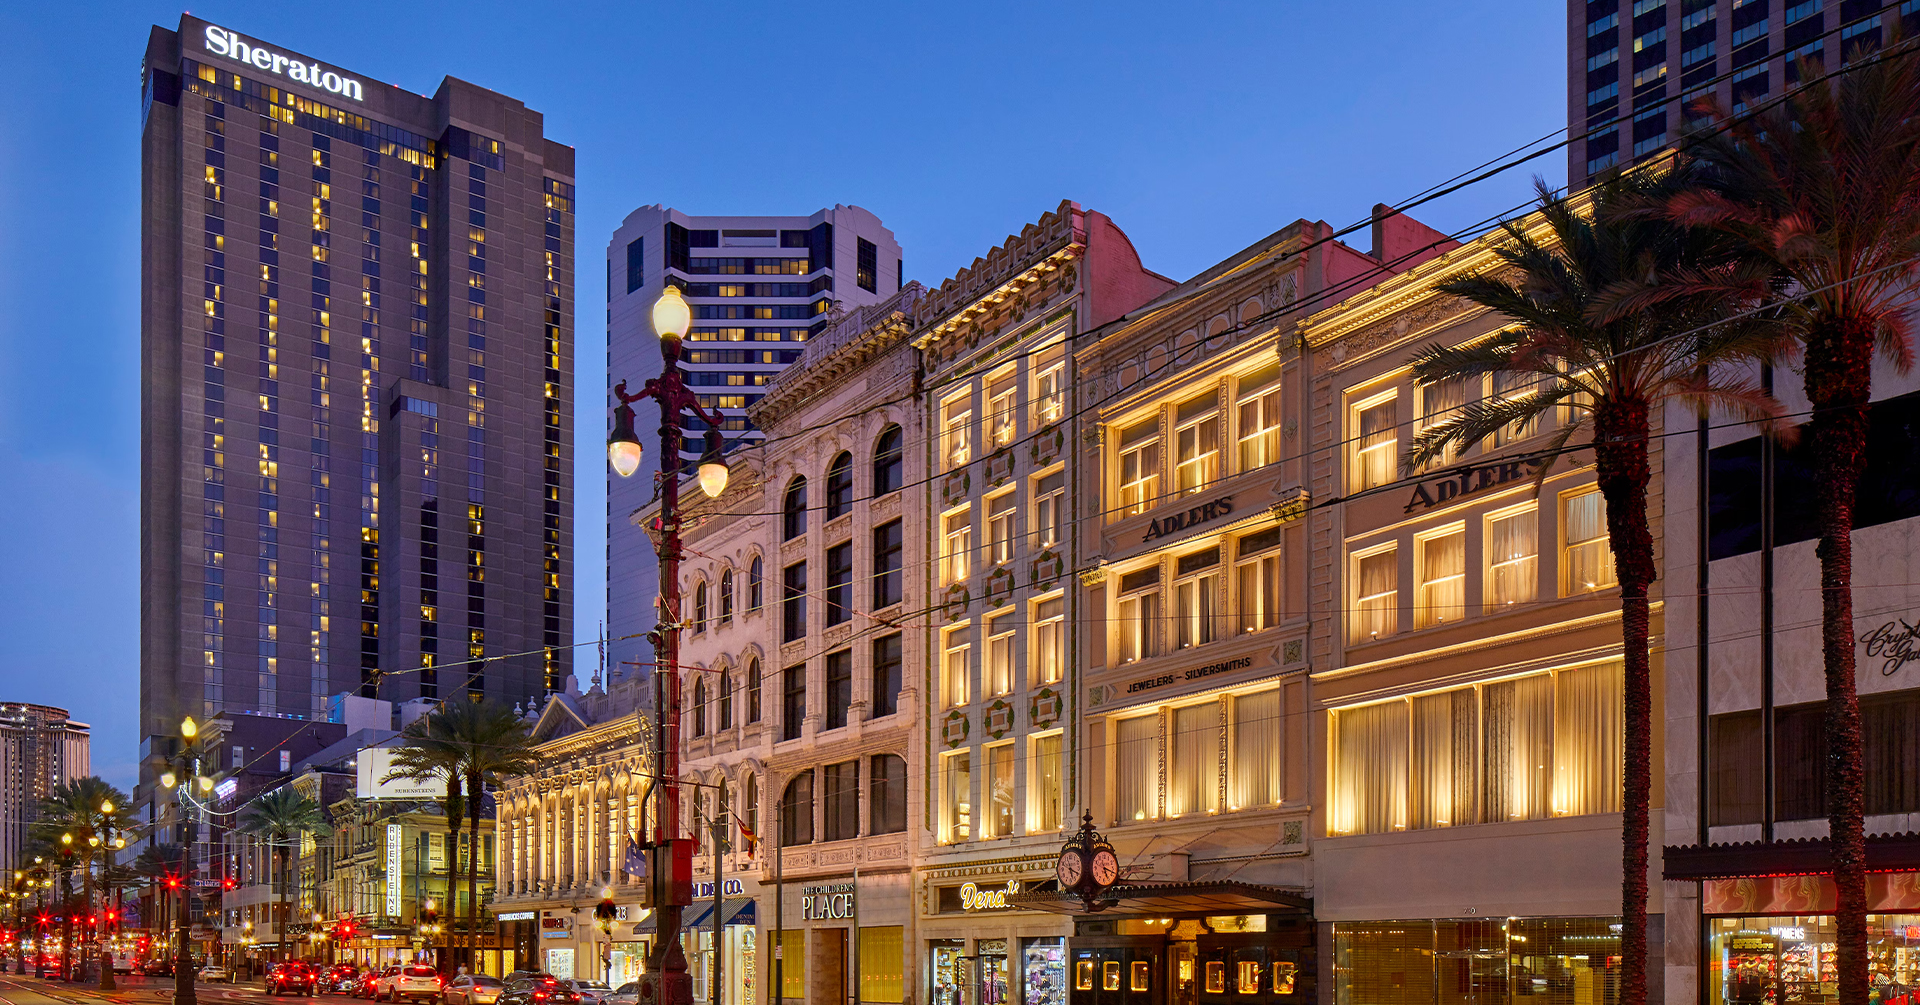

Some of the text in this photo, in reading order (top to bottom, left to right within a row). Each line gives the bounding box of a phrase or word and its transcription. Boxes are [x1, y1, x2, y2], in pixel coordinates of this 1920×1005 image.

[205, 25, 364, 102] Sheraton
[1142, 496, 1232, 543] ADLER'S
[1126, 657, 1251, 694] JEWELERS SILVERSMITHS
[724, 879, 744, 896] CO.
[802, 883, 855, 895] THE CHILDREN'S
[802, 893, 855, 920] PLACE
[1771, 927, 1805, 940] WOMENS
